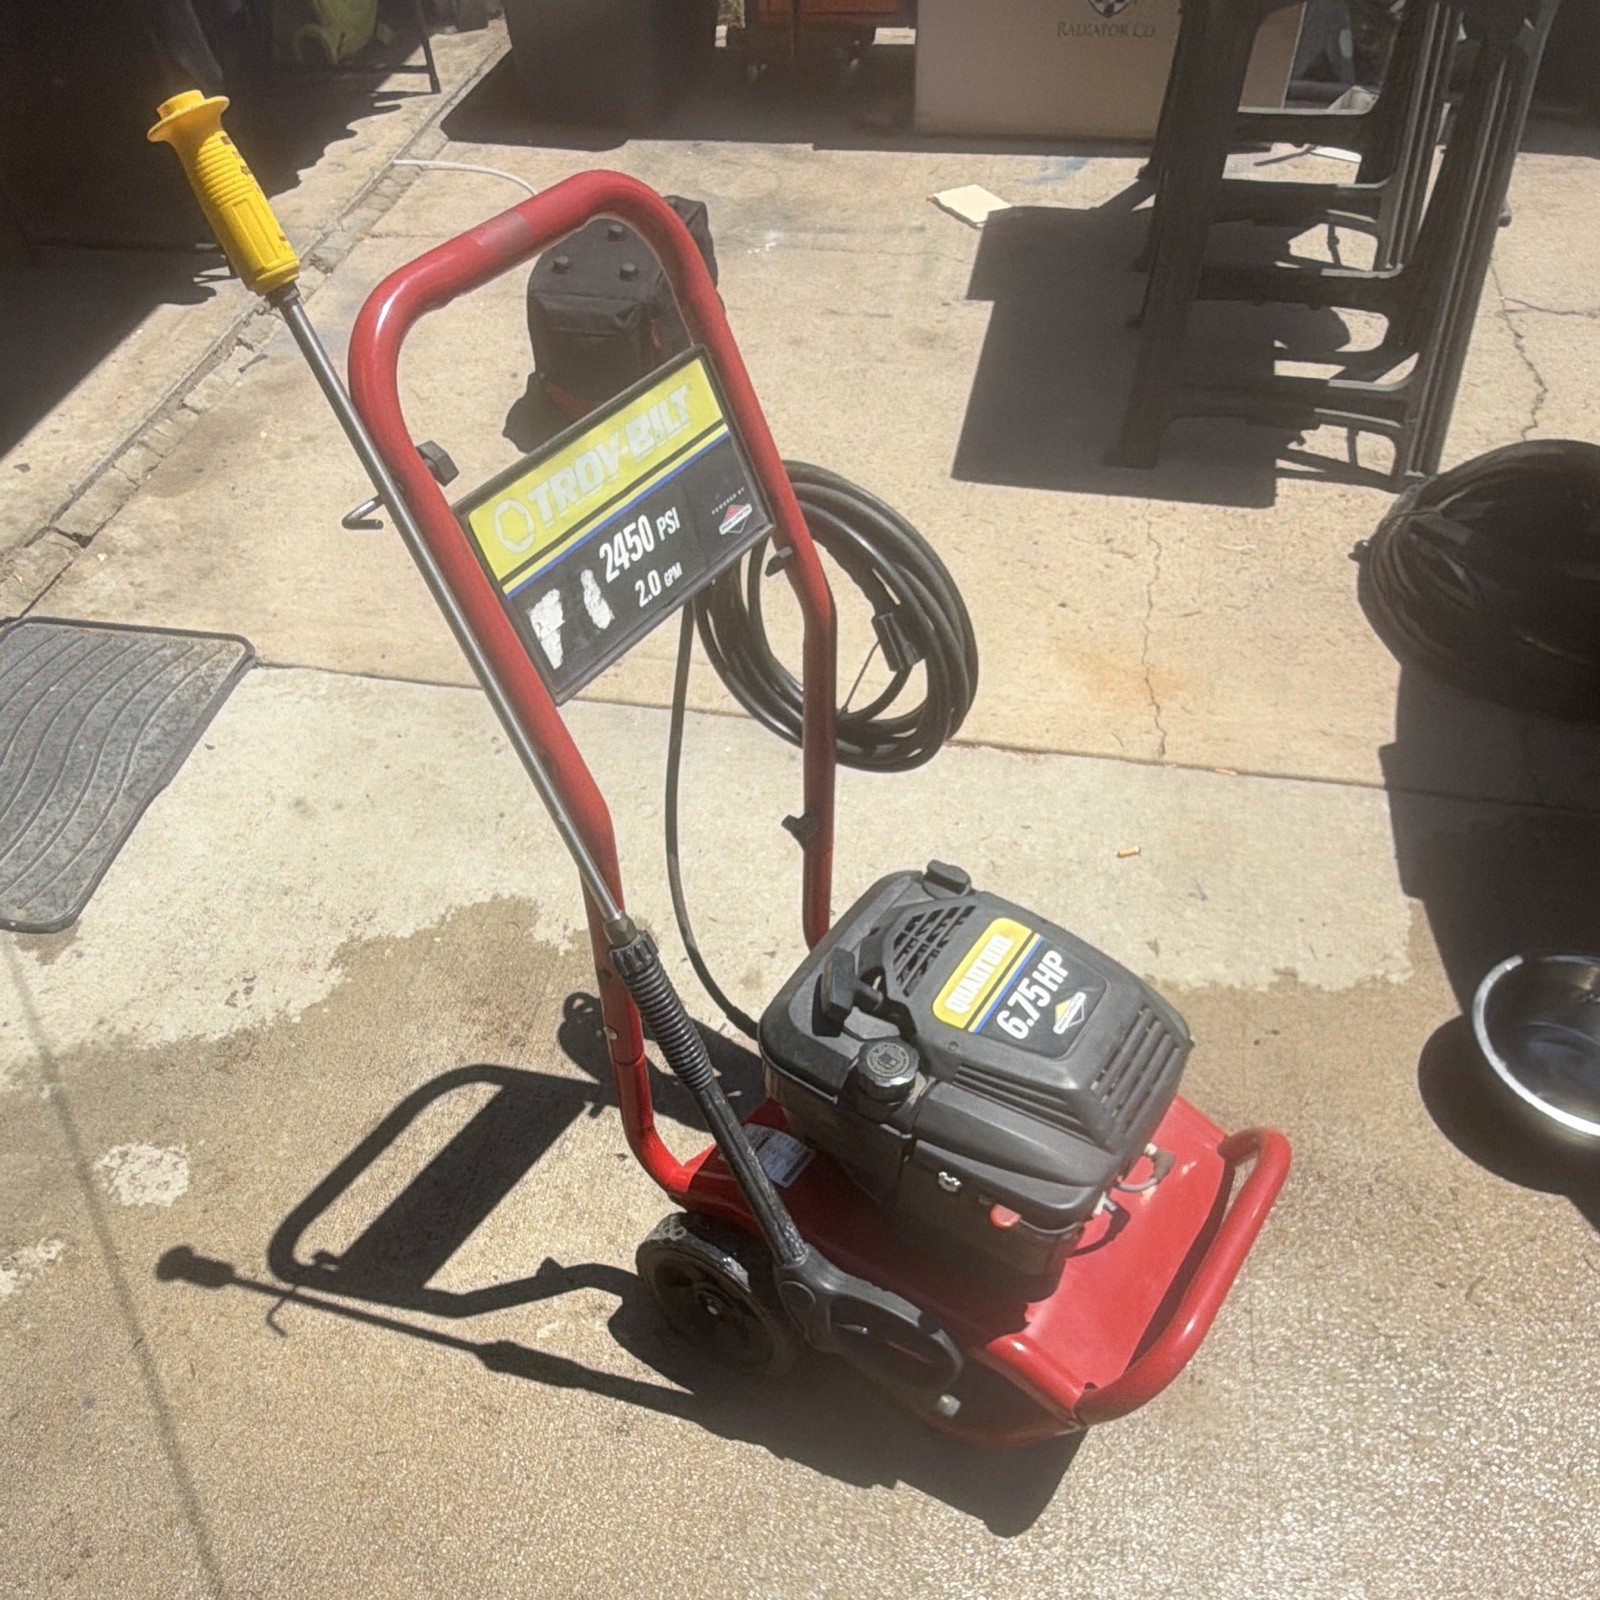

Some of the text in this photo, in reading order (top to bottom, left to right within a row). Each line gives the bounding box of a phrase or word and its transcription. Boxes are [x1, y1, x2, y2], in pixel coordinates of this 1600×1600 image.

[1057, 20, 1129, 38] RADIATOR
[529, 386, 691, 527] TROY-BILT
[600, 515, 656, 584] 2450
[656, 508, 681, 541] PSI
[635, 563, 683, 608] 2.0 GPM
[945, 935, 1014, 1014] QUANTUM
[997, 950, 1068, 1040] 6.75 HP
